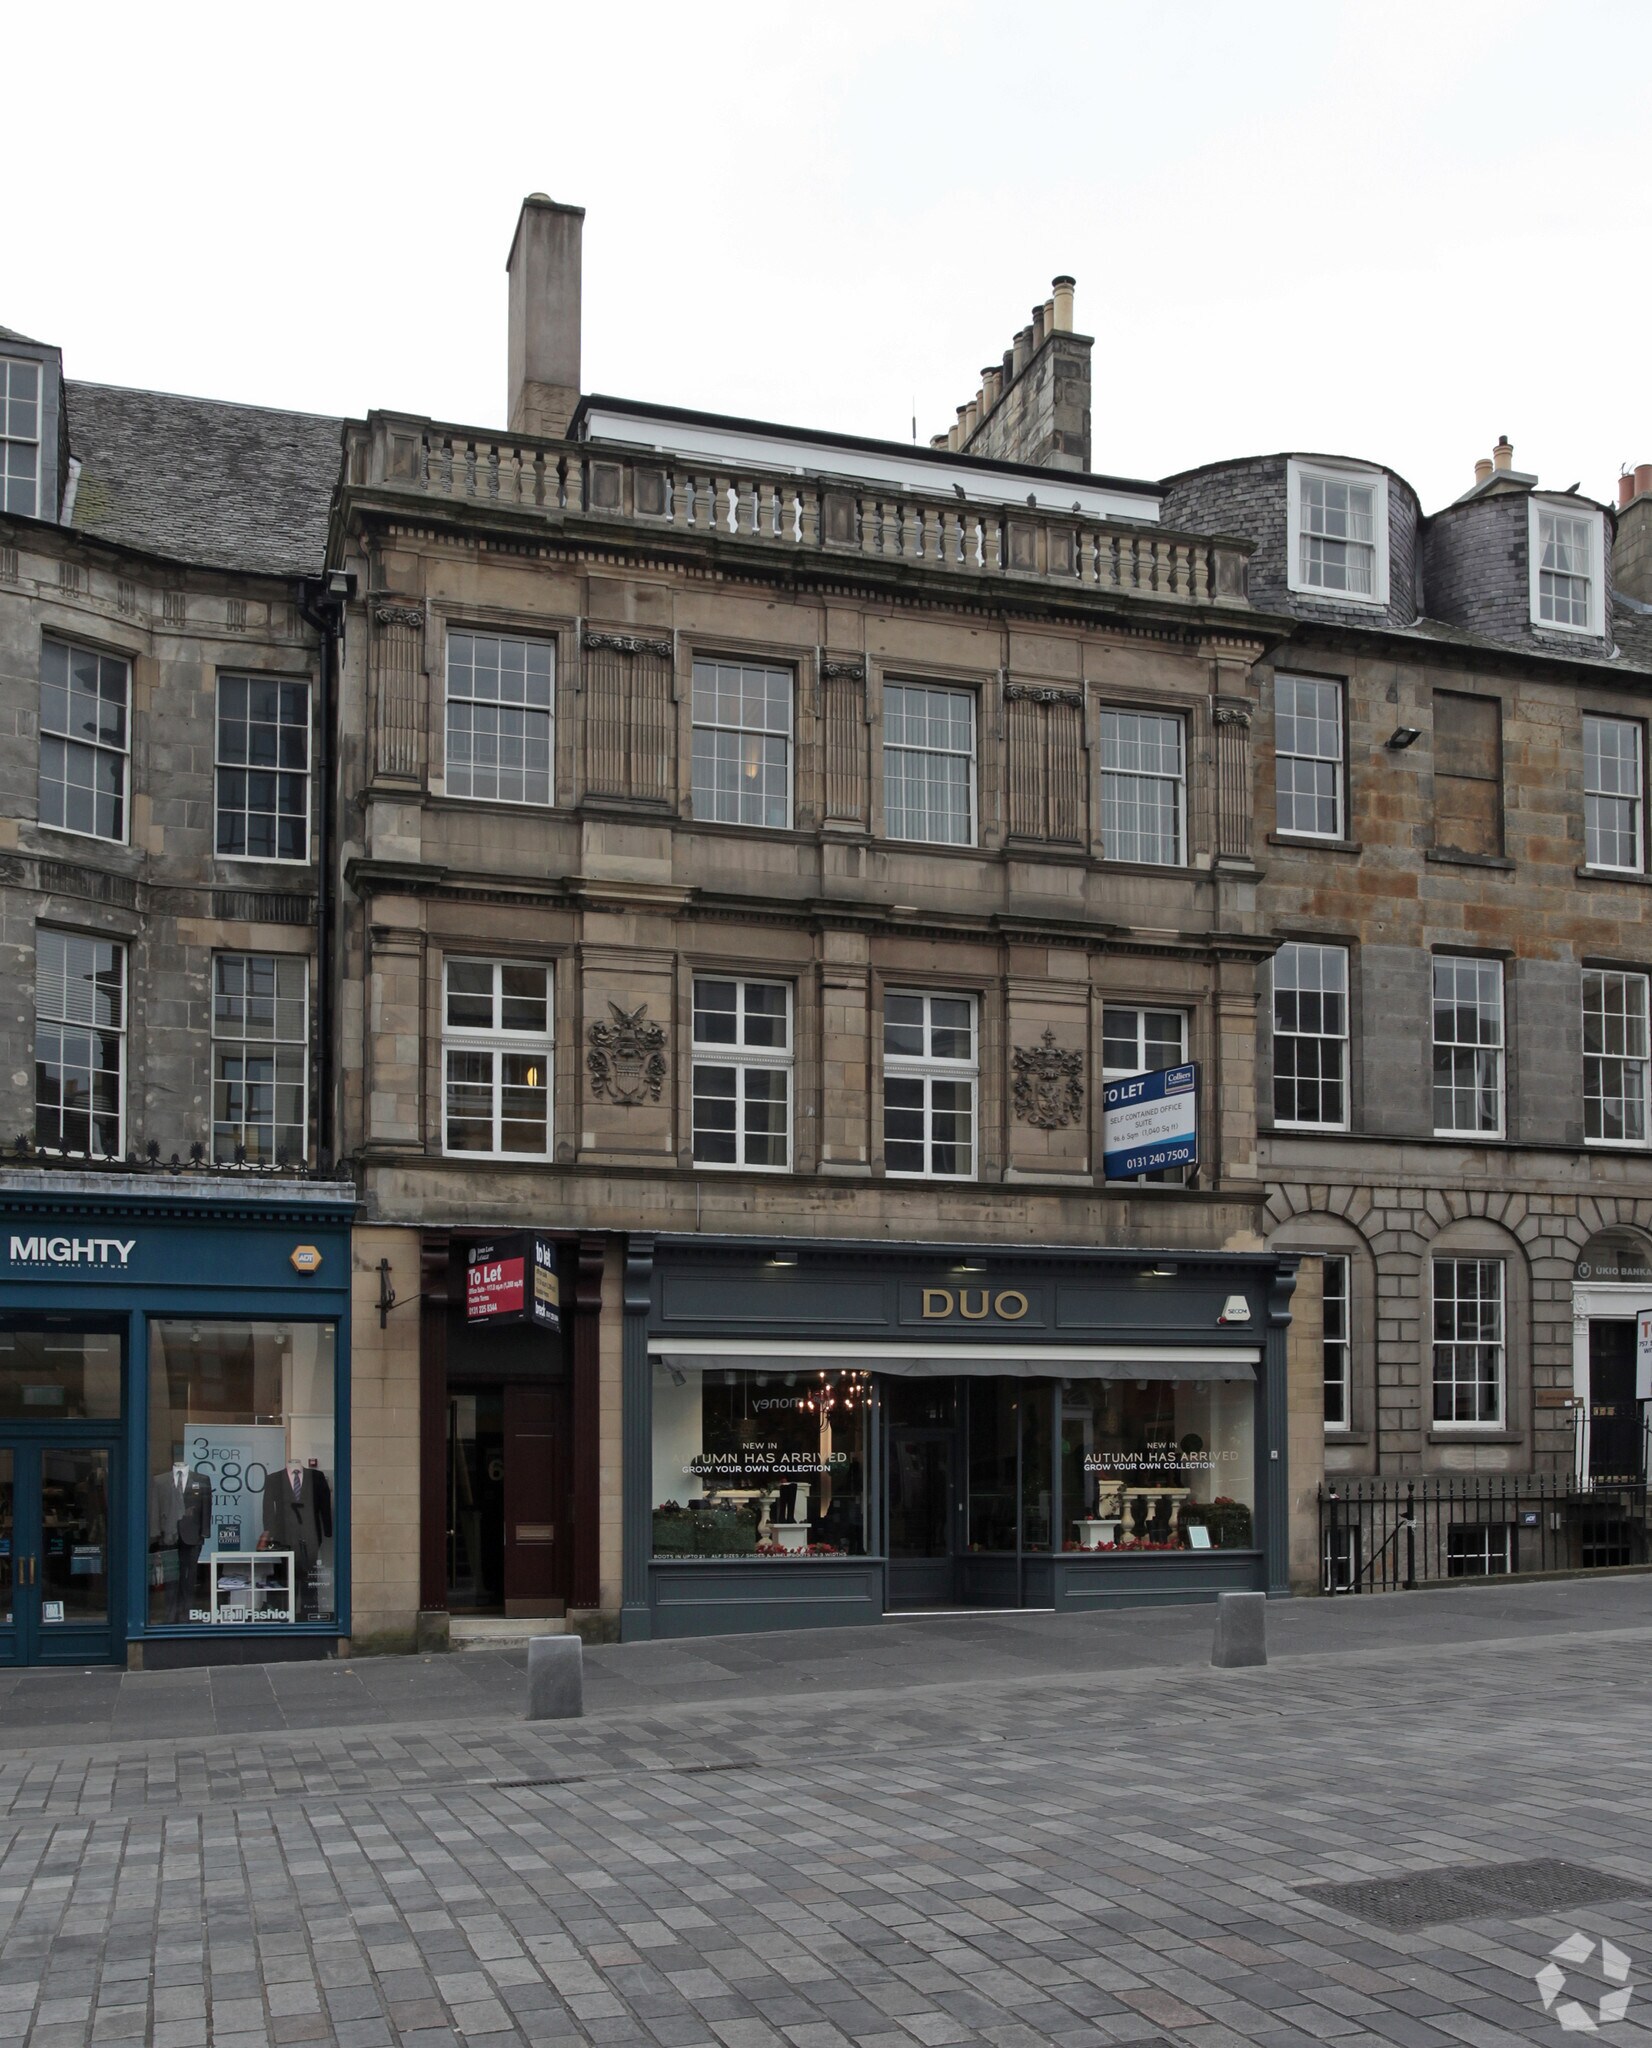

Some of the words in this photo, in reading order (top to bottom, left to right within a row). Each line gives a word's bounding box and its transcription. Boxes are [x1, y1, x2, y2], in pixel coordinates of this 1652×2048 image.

[1168, 1072, 1190, 1082] Colliers
[1103, 1089, 1118, 1104] TO
[1121, 1082, 1144, 1100] LET
[1110, 1116, 1124, 1124] SELF
[1125, 1108, 1158, 1121] CONTAINED
[1160, 1103, 1182, 1113] OFFICE
[1135, 1119, 1152, 1128] SUITE
[1126, 1156, 1147, 1169] 0131
[1149, 1153, 1166, 1165] 240
[1167, 1148, 1189, 1160] 7500
[10, 1236, 136, 1263] MIGHTY
[298, 1253, 314, 1262] ADT
[536, 1241, 543, 1263] to
[543, 1244, 551, 1268] let
[468, 1268, 480, 1286] To
[484, 1264, 502, 1284] Let
[922, 1289, 1028, 1320] DUO
[193, 1438, 210, 1460] 3
[212, 1449, 240, 1460] FOR
[744, 1453, 776, 1464] HAS
[780, 1452, 847, 1463] ARRIVED
[1084, 1452, 1142, 1463] AUTUMN
[1150, 1452, 1176, 1462] HAS
[1180, 1451, 1238, 1462] ARRIVED
[212, 1495, 242, 1506] ITY
[189, 1609, 210, 1622] Big
[222, 1608, 243, 1620] Tall
